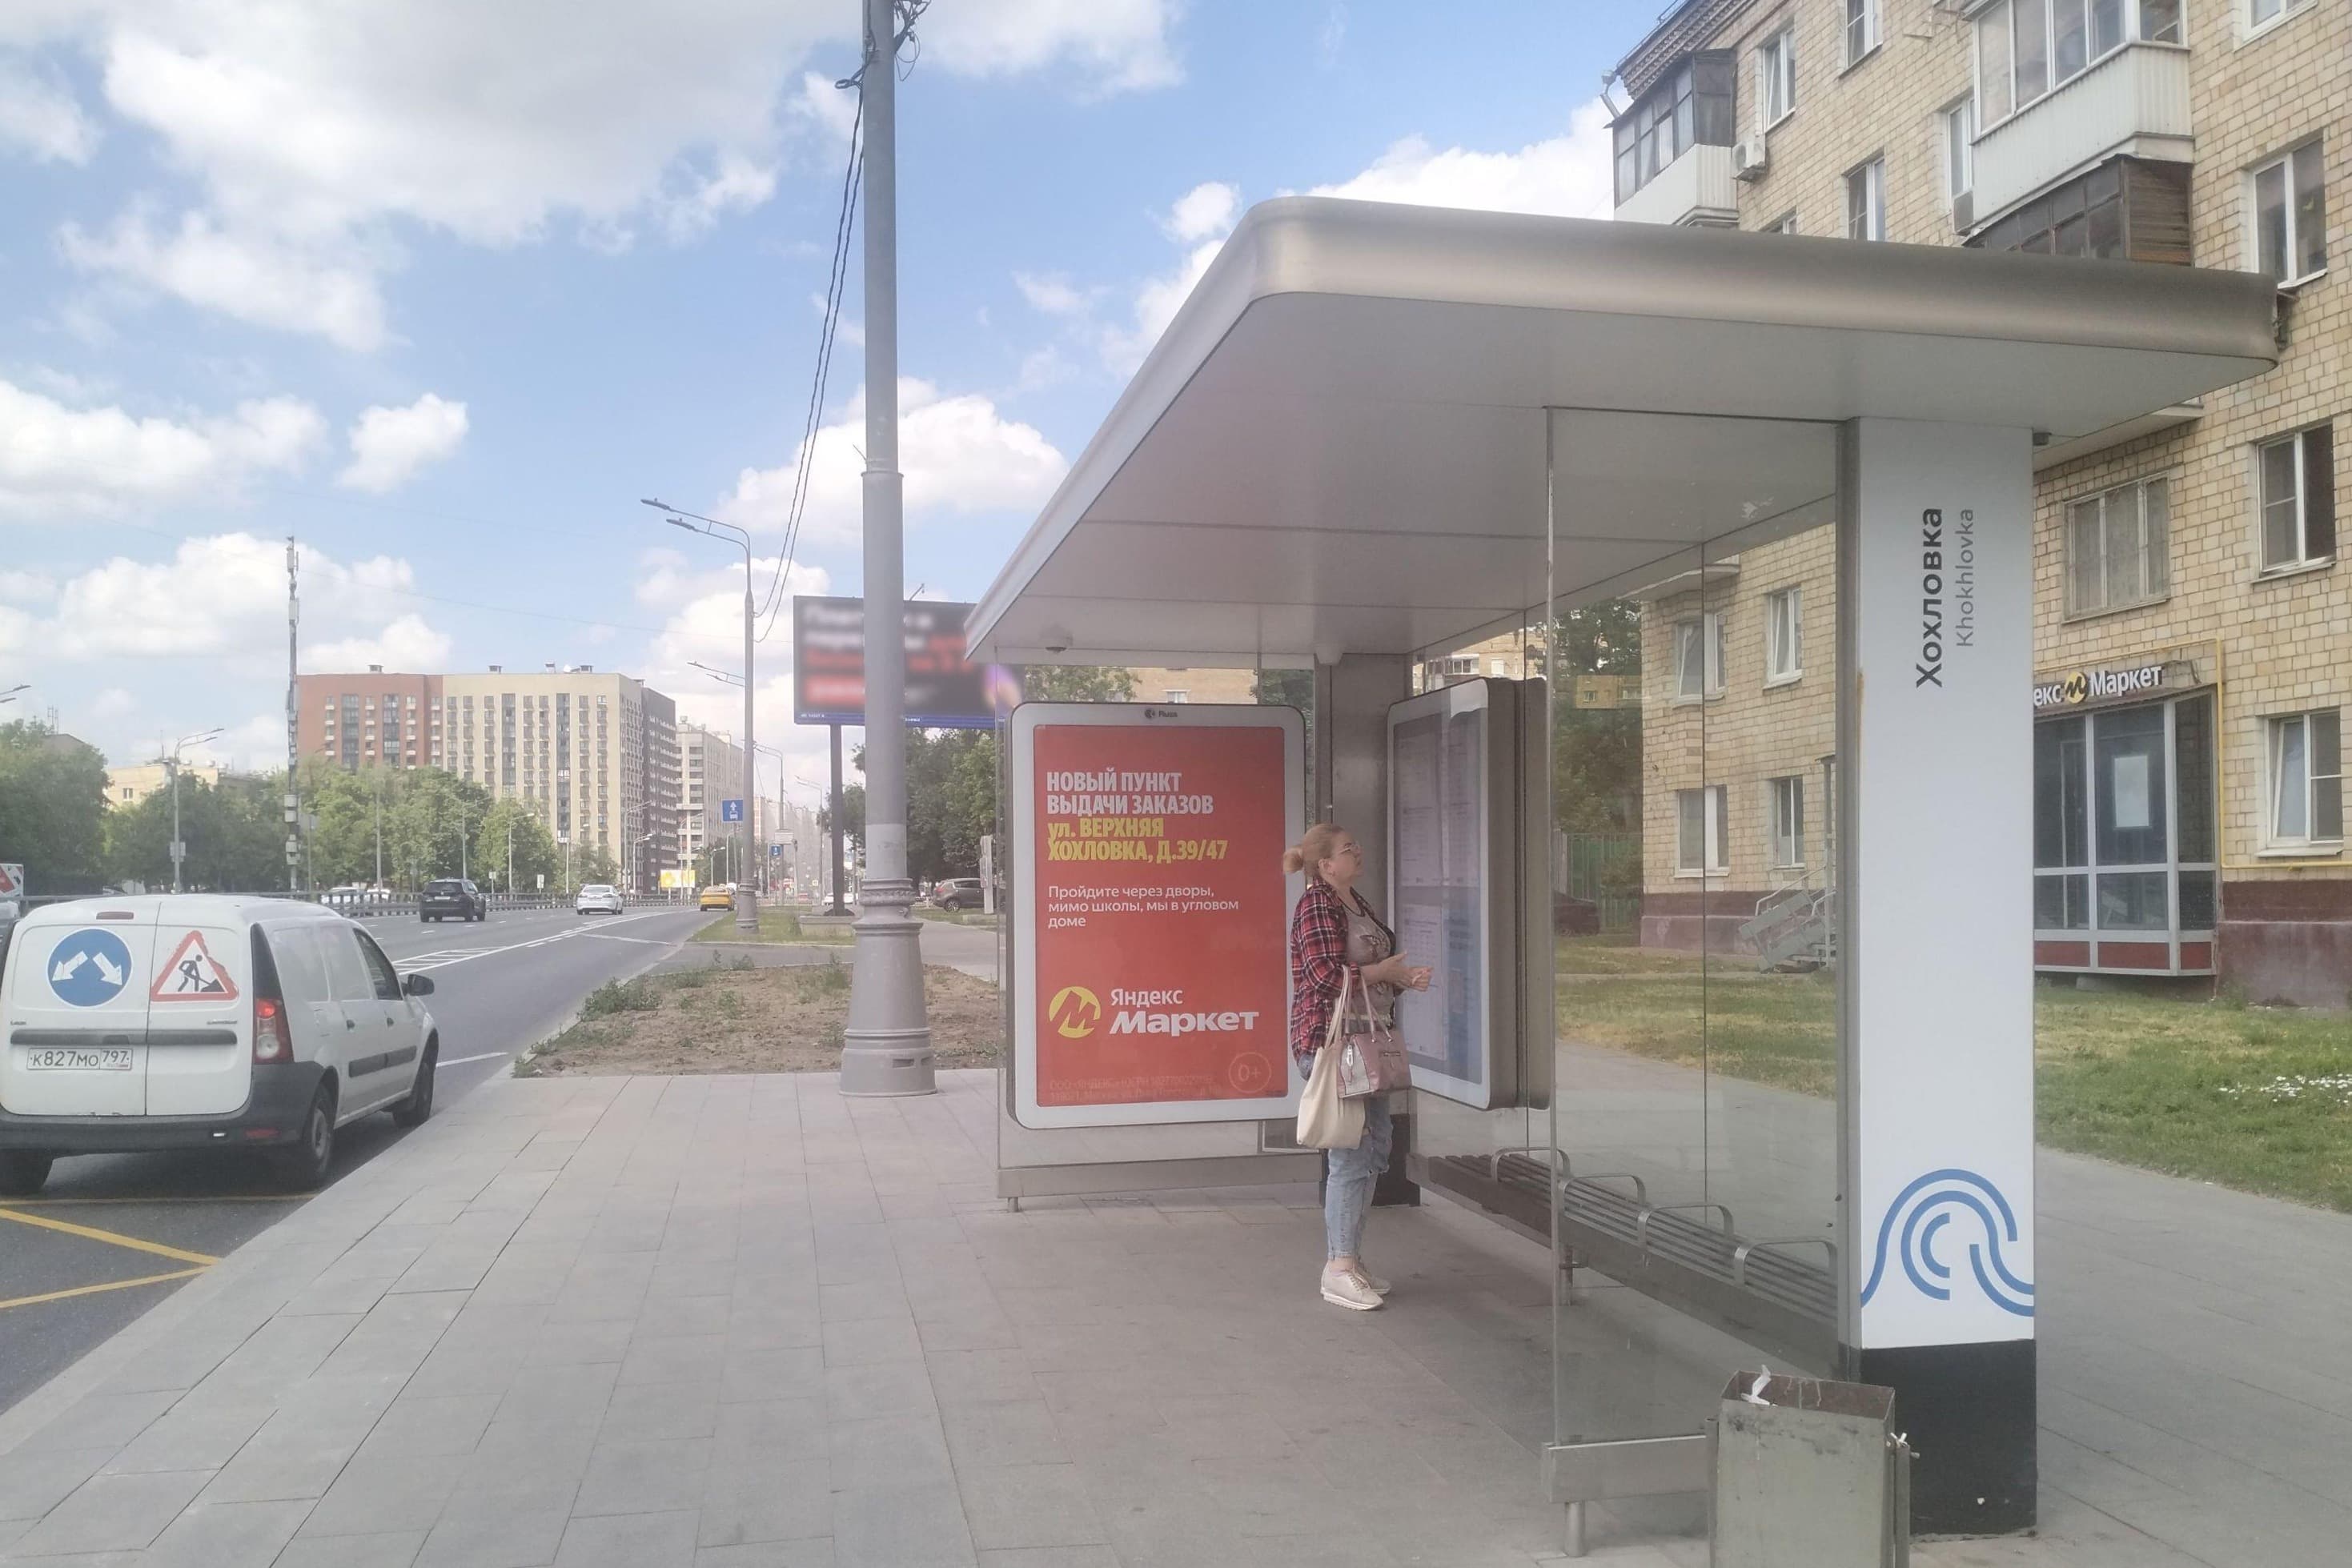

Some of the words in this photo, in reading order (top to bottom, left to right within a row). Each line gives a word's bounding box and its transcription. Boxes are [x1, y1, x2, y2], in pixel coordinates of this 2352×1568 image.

[1955, 508, 1973, 647] Khokhlovka
[1916, 508, 1943, 688] Хохловка
[2089, 666, 2162, 697] Маркет
[1046, 767, 1118, 792] НОВЫЙ
[1121, 772, 1182, 792] ПУНКТ
[1047, 795, 1128, 817] ВЫДАЧИ
[1132, 795, 1214, 815] ЗАКАЗОВ
[1047, 823, 1077, 841] ул.
[1080, 817, 1164, 837] ВЕРХНЯЯ
[1047, 840, 1154, 863] ХОХЛОВКА,
[1156, 840, 1228, 864] Д.39/47
[1048, 885, 1120, 900] Пройдите
[1122, 887, 1163, 900] через
[1165, 886, 1215, 898] дворы,
[1048, 901, 1090, 912] мимо
[1092, 900, 1145, 913] школы,
[1146, 900, 1169, 911] мы
[1171, 901, 1179, 911] в
[1182, 900, 1239, 914] угловом
[1048, 916, 1087, 928] доме
[1110, 989, 1184, 1009] Яндекс
[1109, 1011, 1260, 1037] Маркет
[1238, 1064, 1262, 1082] 0+
